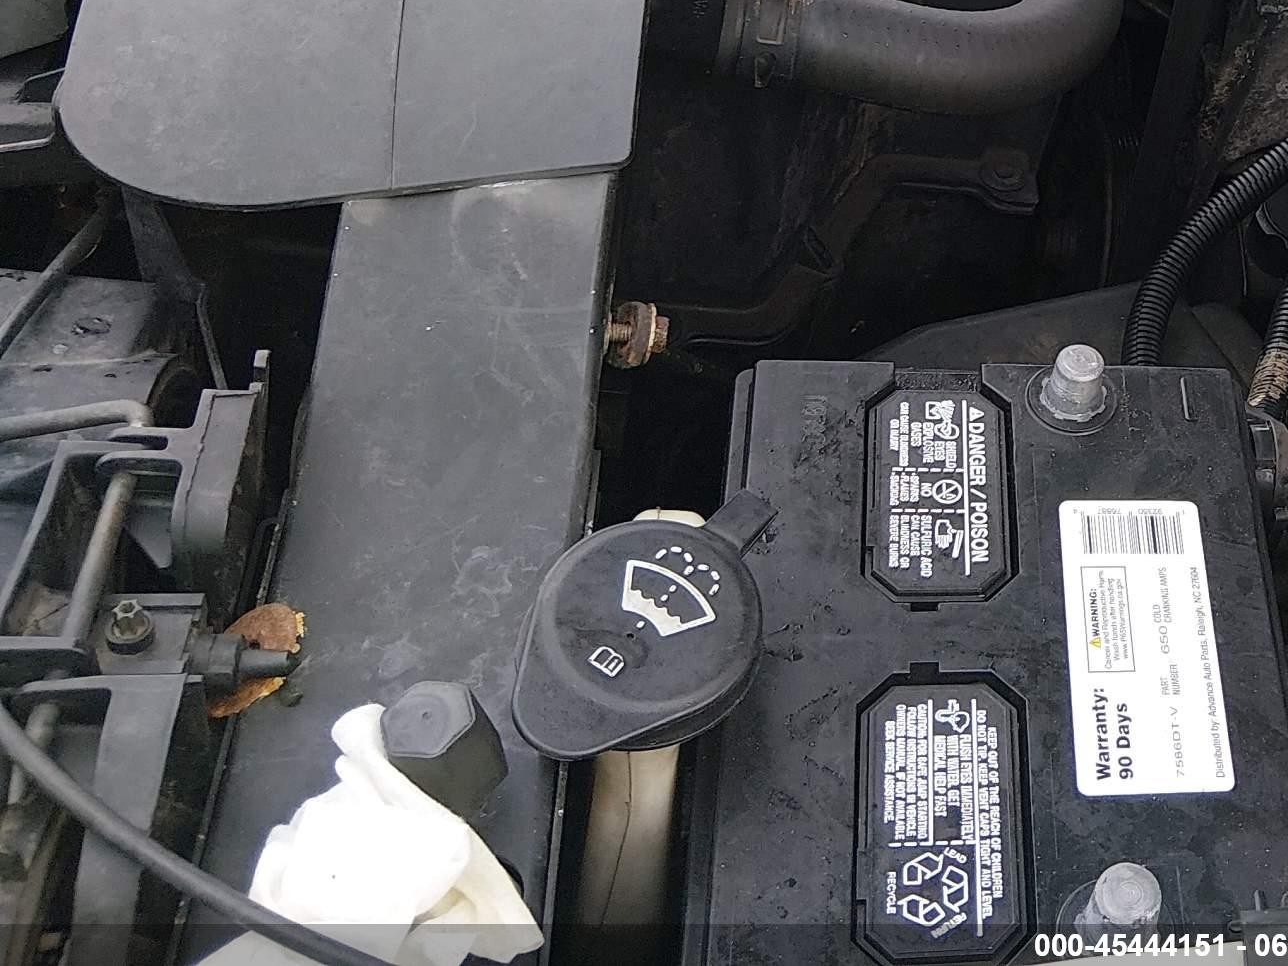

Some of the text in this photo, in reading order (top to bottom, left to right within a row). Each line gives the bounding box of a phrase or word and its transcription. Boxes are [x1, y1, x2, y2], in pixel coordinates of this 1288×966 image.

[911, 422, 921, 447] GASES
[923, 422, 933, 464] EXPLOSIVE
[934, 441, 945, 460] EYES
[946, 441, 956, 468] SHIELD
[921, 483, 932, 496] NO
[969, 423, 989, 562] DANGER / POISON
[890, 515, 899, 567] SEVERE BURNS
[900, 515, 909, 567] BLINDNESS OR
[911, 515, 920, 556] CAN CAUSE
[921, 515, 932, 577] SULFURIC ACID
[1100, 590, 1109, 630] Reproductive
[1158, 567, 1172, 654] 650 CRANKING AMPS
[1193, 591, 1201, 603] NC
[1090, 589, 1100, 637] WARNING:
[1153, 605, 1162, 623] COLD
[1104, 646, 1112, 669] Cancer
[1202, 662, 1210, 679] Auto
[1160, 677, 1169, 695] PART
[1169, 664, 1181, 695] NUMBER
[1204, 682, 1216, 717] Advance
[977, 710, 986, 722] DO
[885, 721, 894, 740] SEEK
[977, 725, 986, 742] NOT
[1092, 688, 1111, 780] Warranty:
[1116, 703, 1133, 779] 90 Days
[885, 742, 894, 772] SERVICE
[918, 739, 927, 755] FOR
[947, 735, 959, 755] WITH
[1211, 733, 1225, 777] Distributed
[907, 707, 916, 837] FOLLOW INSTRUCTIONS IN VEHICLE
[918, 757, 927, 776] SAFE
[934, 736, 947, 816] MEDICAL HELP FAST
[978, 764, 987, 785] KEEP
[896, 781, 905, 798] NOT
[918, 778, 927, 798] JUMP
[948, 790, 960, 806] GET
[960, 735, 974, 840] FLUSH EYES IMMEDIATELY
[979, 787, 988, 809] VENT
[896, 800, 906, 839] AVAILABLE
[918, 801, 927, 838] STARTING
[980, 812, 990, 837] CAPS
[987, 727, 1002, 897] KEEP OUT OF THE REACH OF CHILDREN
[944, 847, 967, 864] LEAD
[981, 840, 991, 866] TIGHT
[982, 869, 991, 888] AND
[887, 872, 897, 914] RECYCLE
[982, 891, 992, 918] LEVEL
[931, 912, 967, 939] RETURN
